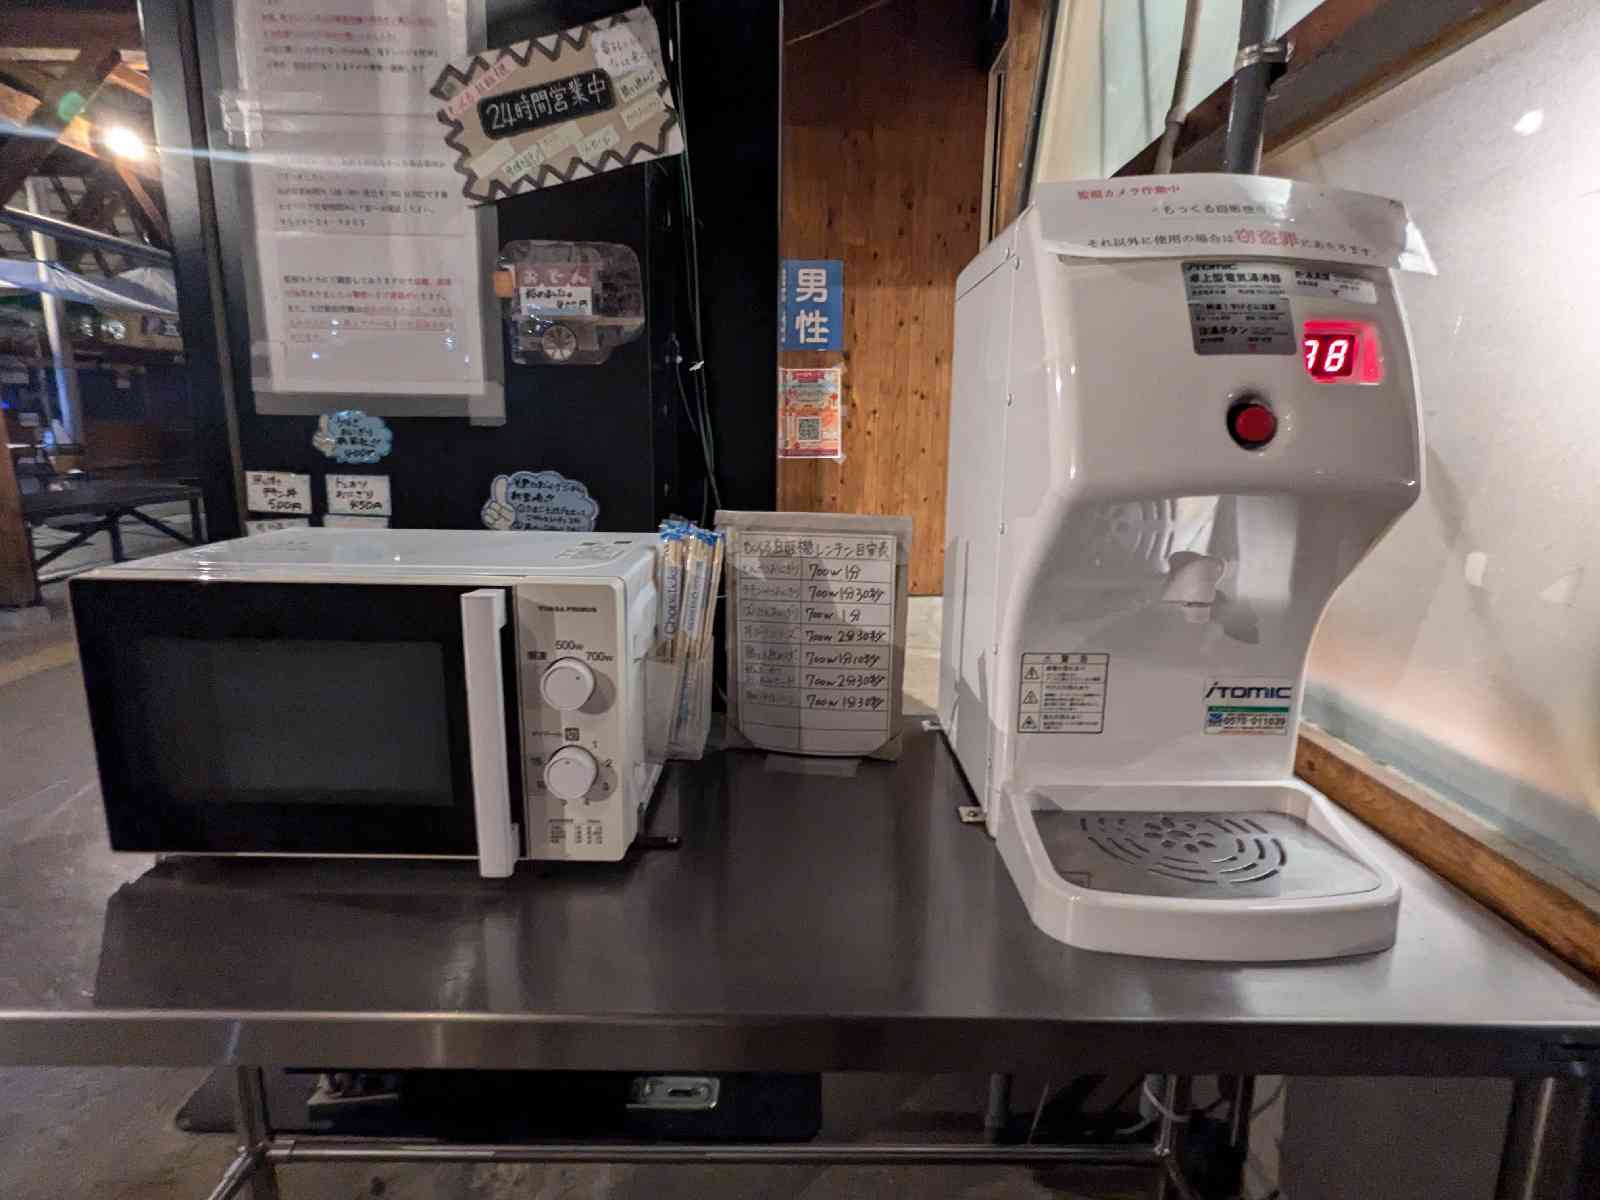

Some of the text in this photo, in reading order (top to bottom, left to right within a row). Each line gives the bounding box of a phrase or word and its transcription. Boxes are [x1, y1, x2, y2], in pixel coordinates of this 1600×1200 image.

[487, 73, 607, 130] 24時間営業中
[795, 267, 830, 344] 男性
[268, 499, 303, 511] 500円
